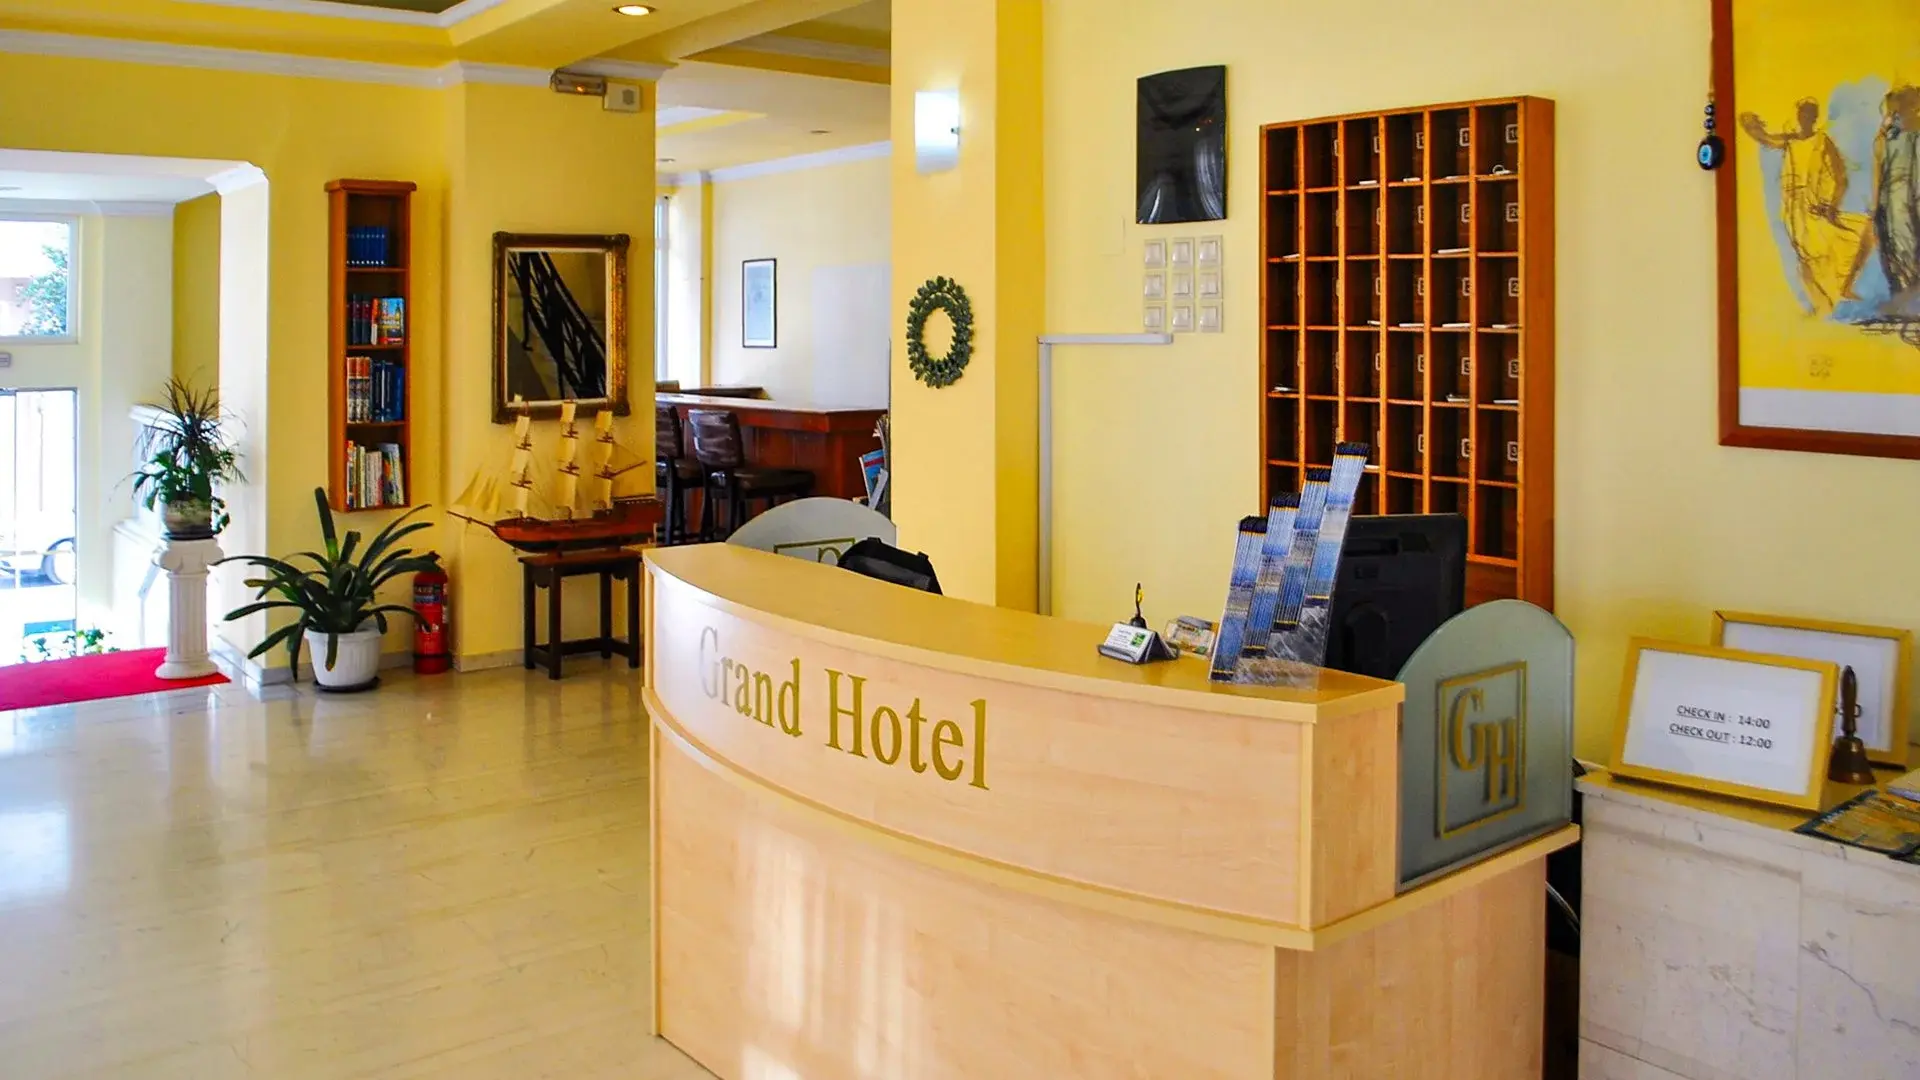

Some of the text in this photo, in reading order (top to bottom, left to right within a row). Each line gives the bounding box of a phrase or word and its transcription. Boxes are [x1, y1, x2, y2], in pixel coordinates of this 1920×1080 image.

[700, 626, 990, 791] Grand Hotel
[1669, 723, 1703, 737] CHECK
[1706, 729, 1730, 740] OUT
[1740, 734, 1772, 749] 12:00
[1676, 705, 1711, 719] CHECK
[1714, 711, 1725, 721] IN
[1738, 715, 1770, 729] 14:00
[1453, 687, 1517, 805] GH
